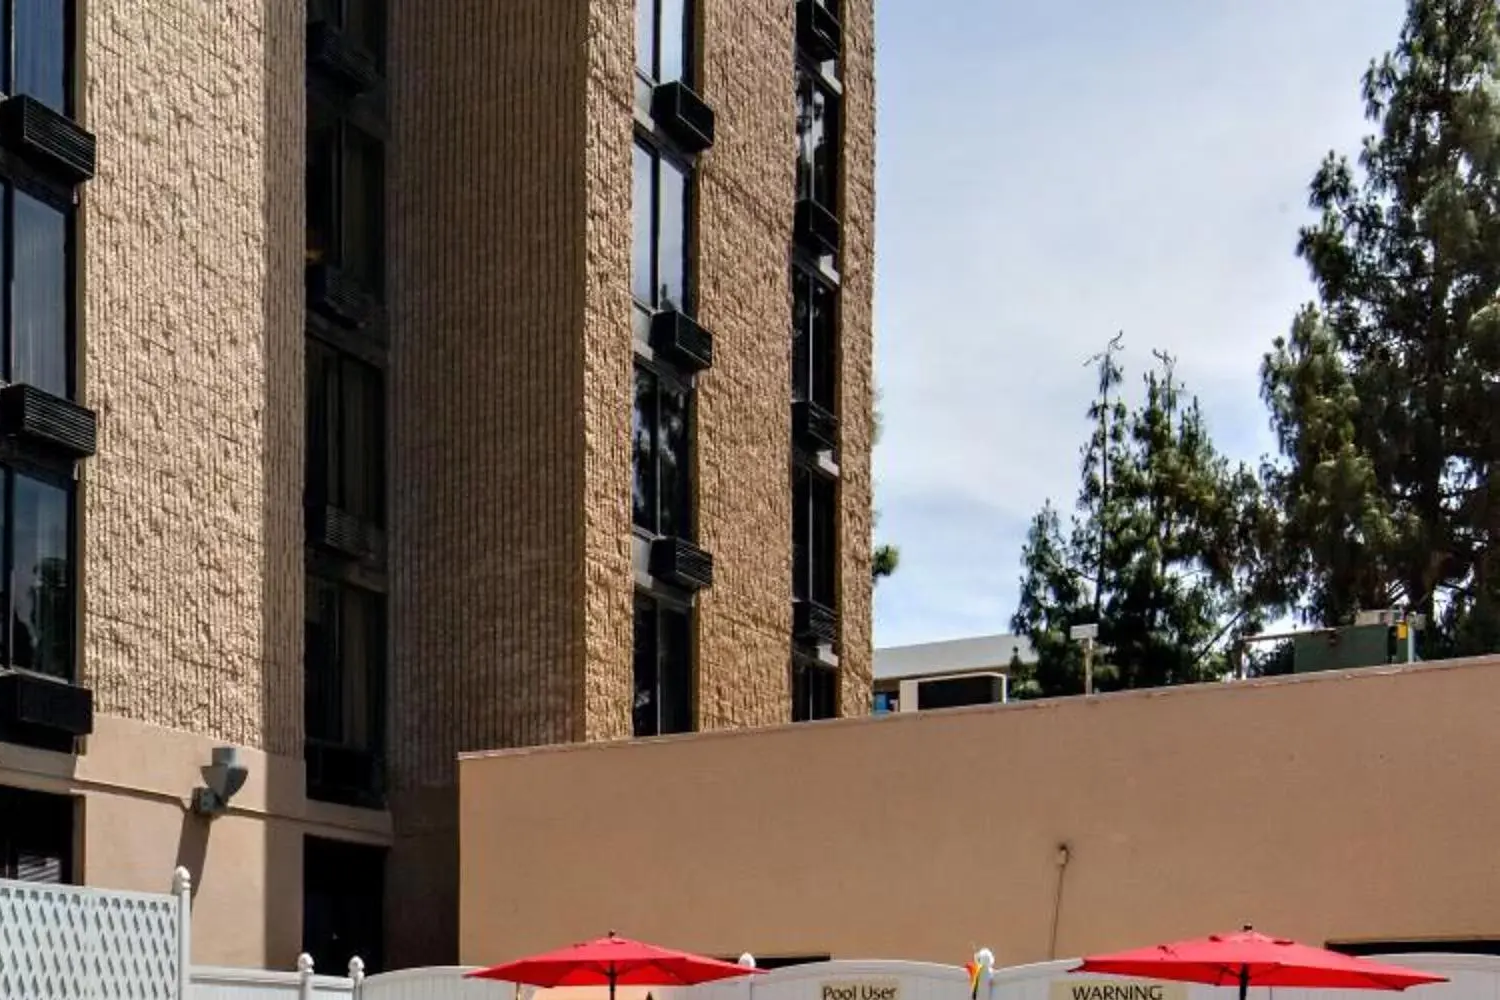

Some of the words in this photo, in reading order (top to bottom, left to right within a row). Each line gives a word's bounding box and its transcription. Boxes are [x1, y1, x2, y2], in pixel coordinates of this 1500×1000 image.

[823, 985, 857, 1000] Pool
[861, 984, 897, 1000] User
[1072, 985, 1163, 1000] WARNING
